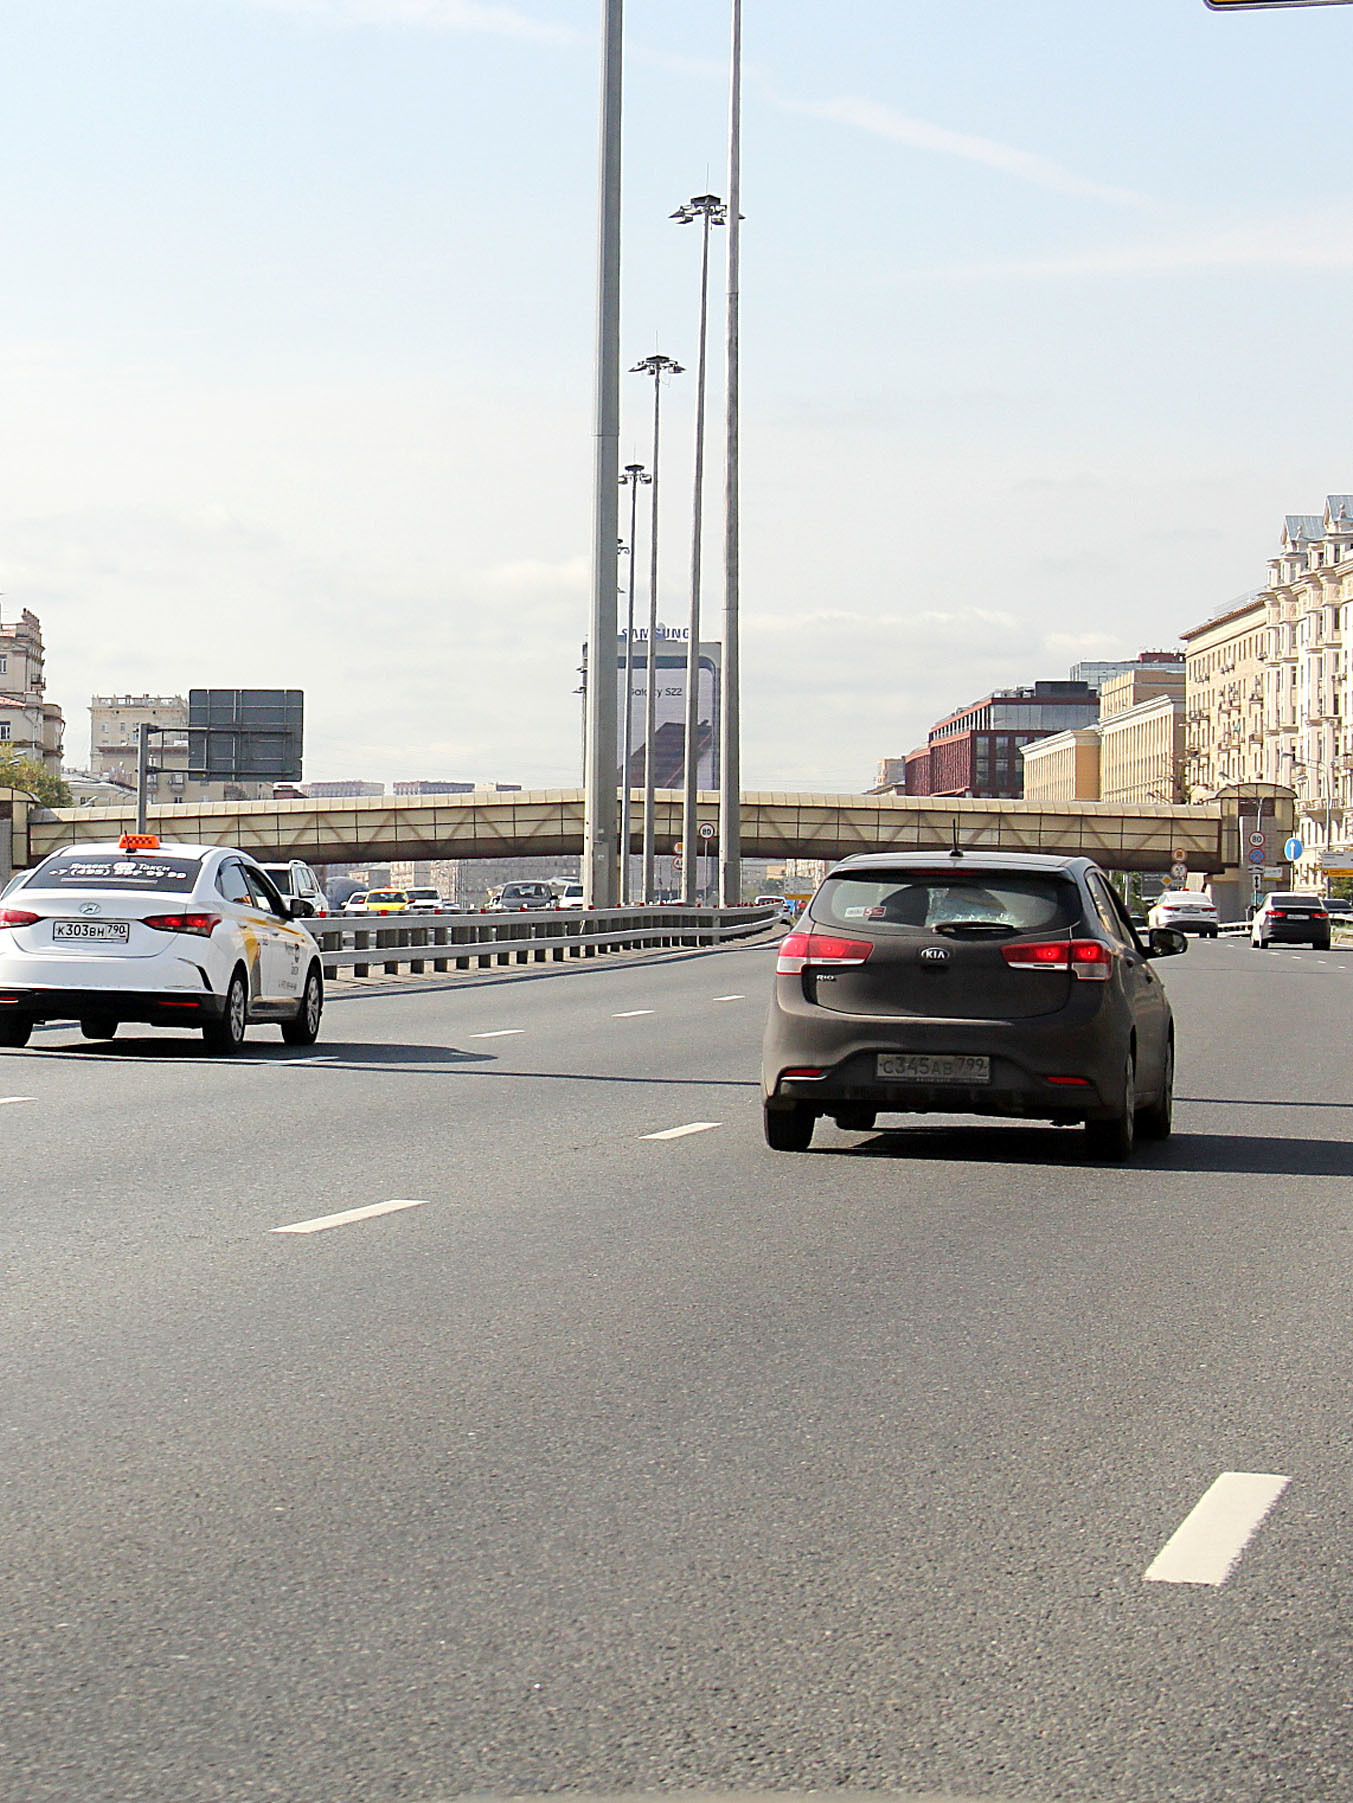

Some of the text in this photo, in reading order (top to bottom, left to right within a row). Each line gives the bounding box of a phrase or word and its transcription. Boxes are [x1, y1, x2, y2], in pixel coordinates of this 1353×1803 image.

[621, 628, 689, 639] SAMSUNG
[665, 688, 682, 696] S22
[57, 924, 125, 936] К303ВН 790
[926, 950, 946, 959] KIA
[816, 974, 835, 982] RIO
[882, 1056, 985, 1076] С345АВ 799
